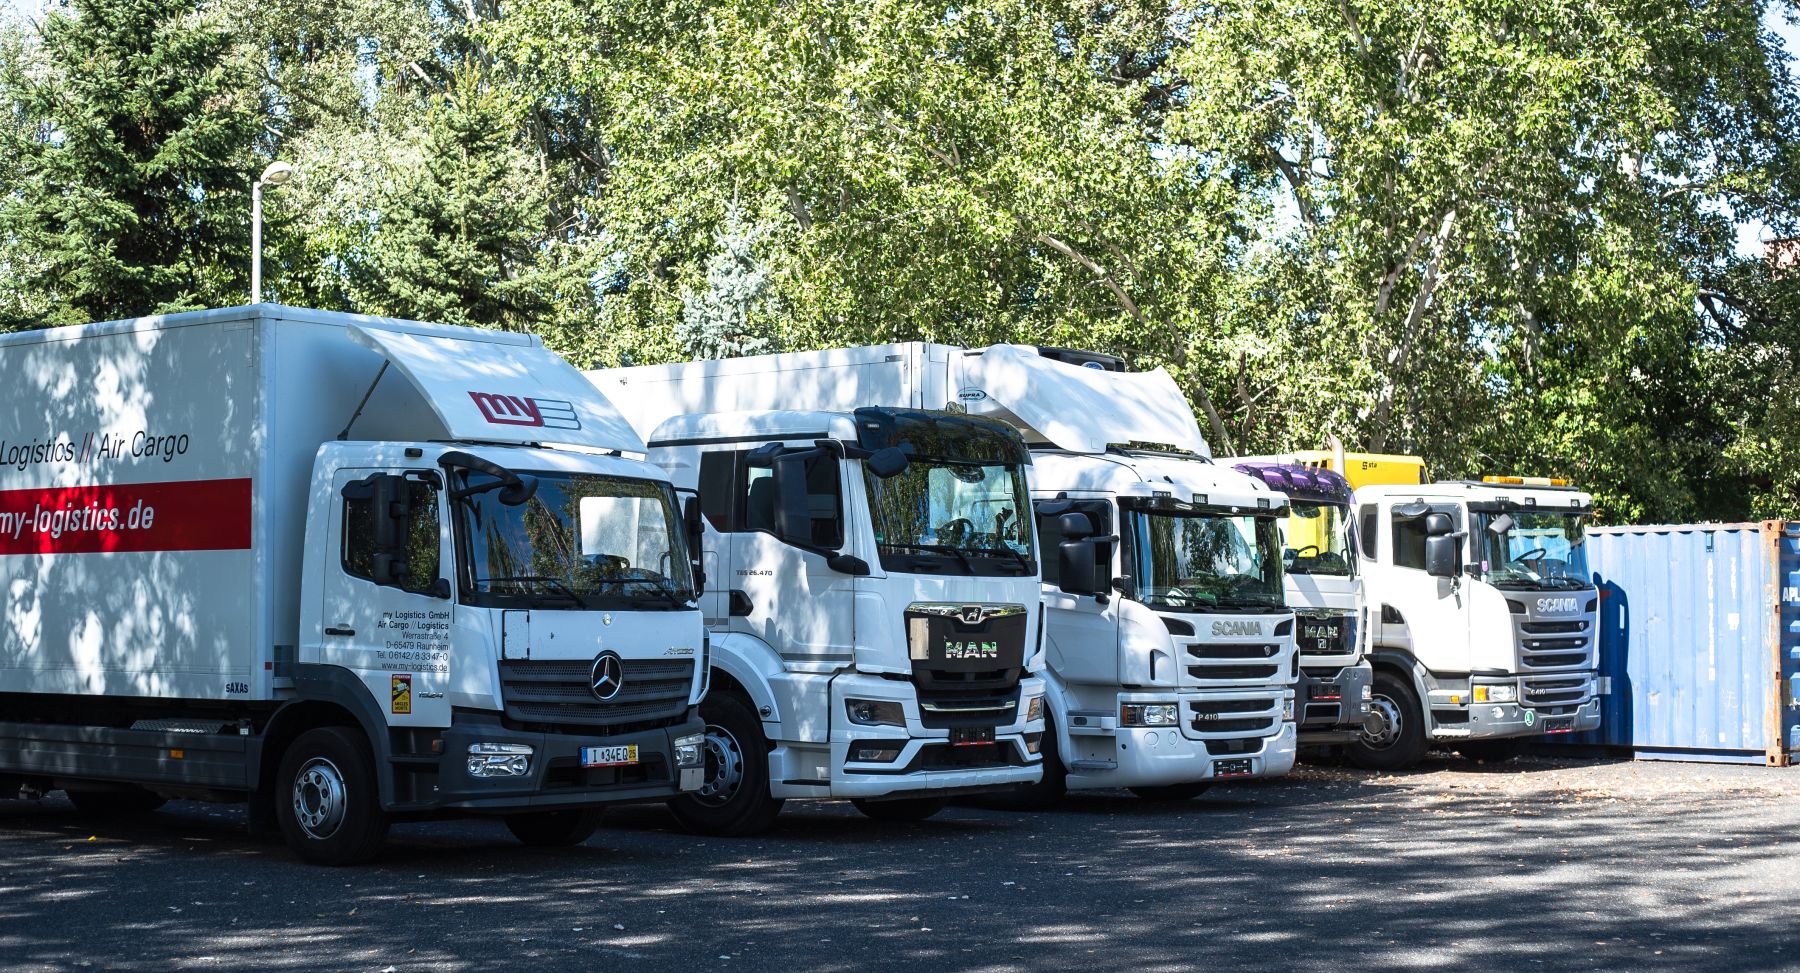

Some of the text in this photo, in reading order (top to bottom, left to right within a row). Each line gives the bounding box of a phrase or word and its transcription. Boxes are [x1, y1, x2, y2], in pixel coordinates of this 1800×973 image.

[468, 391, 544, 427] my
[0, 438, 75, 471] Logistics
[97, 433, 125, 459] Air
[132, 431, 189, 462] Cargo
[0, 499, 154, 539] my-logistics.de
[1537, 598, 1578, 612] SCANIA
[395, 610, 426, 620] Logistics
[428, 611, 450, 619] GmbH
[377, 620, 387, 629] Air
[389, 621, 409, 630] Cargo
[417, 621, 449, 631] Logistics
[1211, 621, 1262, 636] SCANIA
[1304, 625, 1338, 638] MAN
[402, 631, 441, 640] Werrastraße
[386, 641, 449, 651] D-65479 Raunheim
[945, 641, 997, 659] MAN
[376, 651, 386, 659] Tel.
[381, 663, 448, 672] www.my-logistics.de
